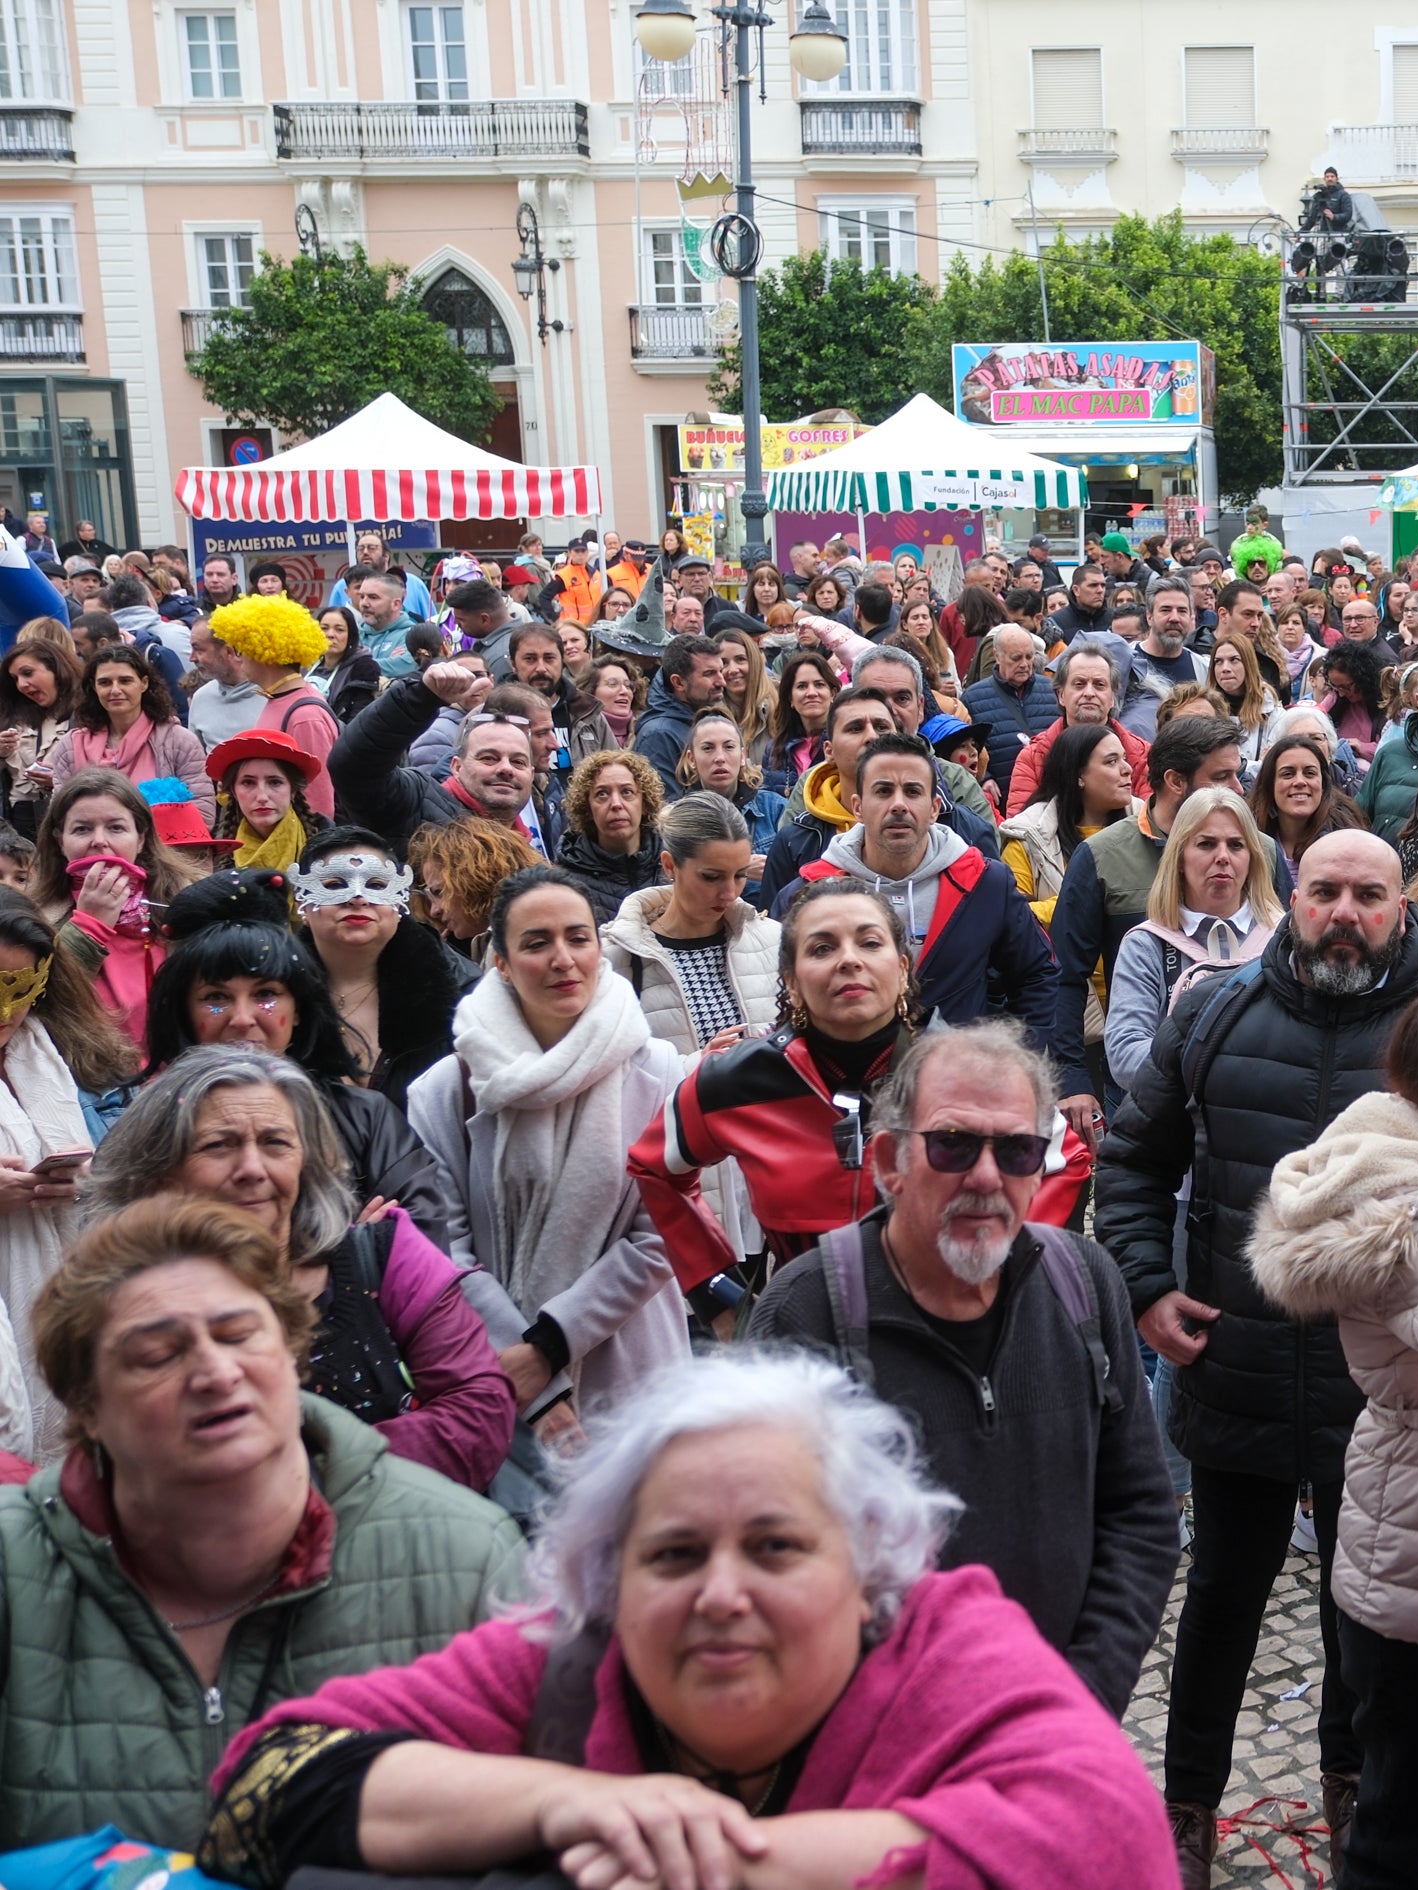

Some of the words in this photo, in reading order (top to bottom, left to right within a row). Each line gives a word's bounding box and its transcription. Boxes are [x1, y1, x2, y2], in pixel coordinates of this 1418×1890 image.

[973, 352, 1079, 391] PATATAS
[1085, 352, 1178, 390] ASADAS
[997, 395, 1026, 415] EL
[1030, 393, 1084, 415] MAC
[1088, 392, 1148, 414] PAPA
[787, 429, 848, 444] GOFRES
[933, 485, 971, 496] Fundación
[981, 485, 1017, 500] Cajasol
[205, 534, 297, 553] DEMUESTRA
[302, 532, 321, 547] TU
